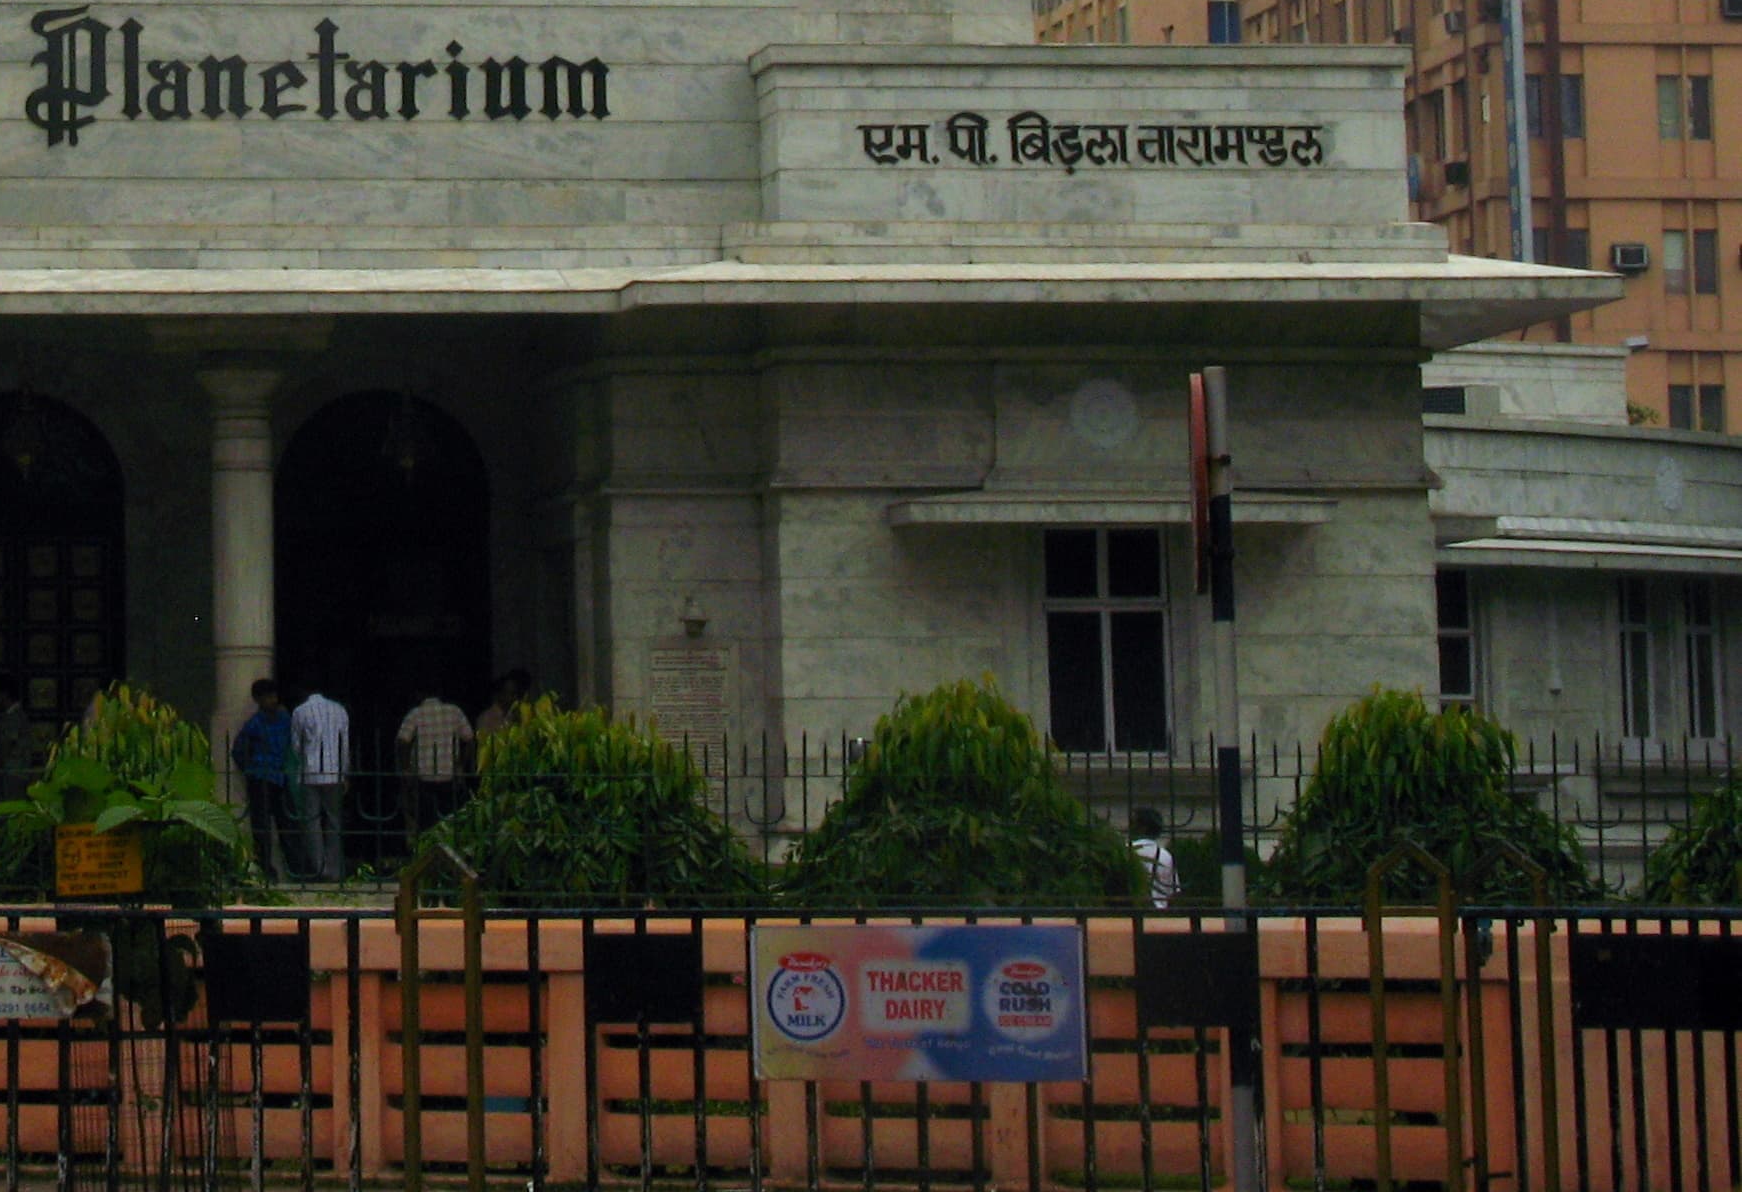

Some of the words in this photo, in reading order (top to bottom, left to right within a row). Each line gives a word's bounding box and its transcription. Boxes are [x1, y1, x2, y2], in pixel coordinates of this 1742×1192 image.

[25, 3, 611, 149] Planetarium
[1137, 124, 1324, 167] तारामण्डल
[866, 970, 963, 993] THACKER
[999, 981, 1051, 996] COLD
[885, 998, 946, 1021] DAIRY
[999, 998, 1051, 1011] RUSH
[787, 1014, 826, 1026] MILK
